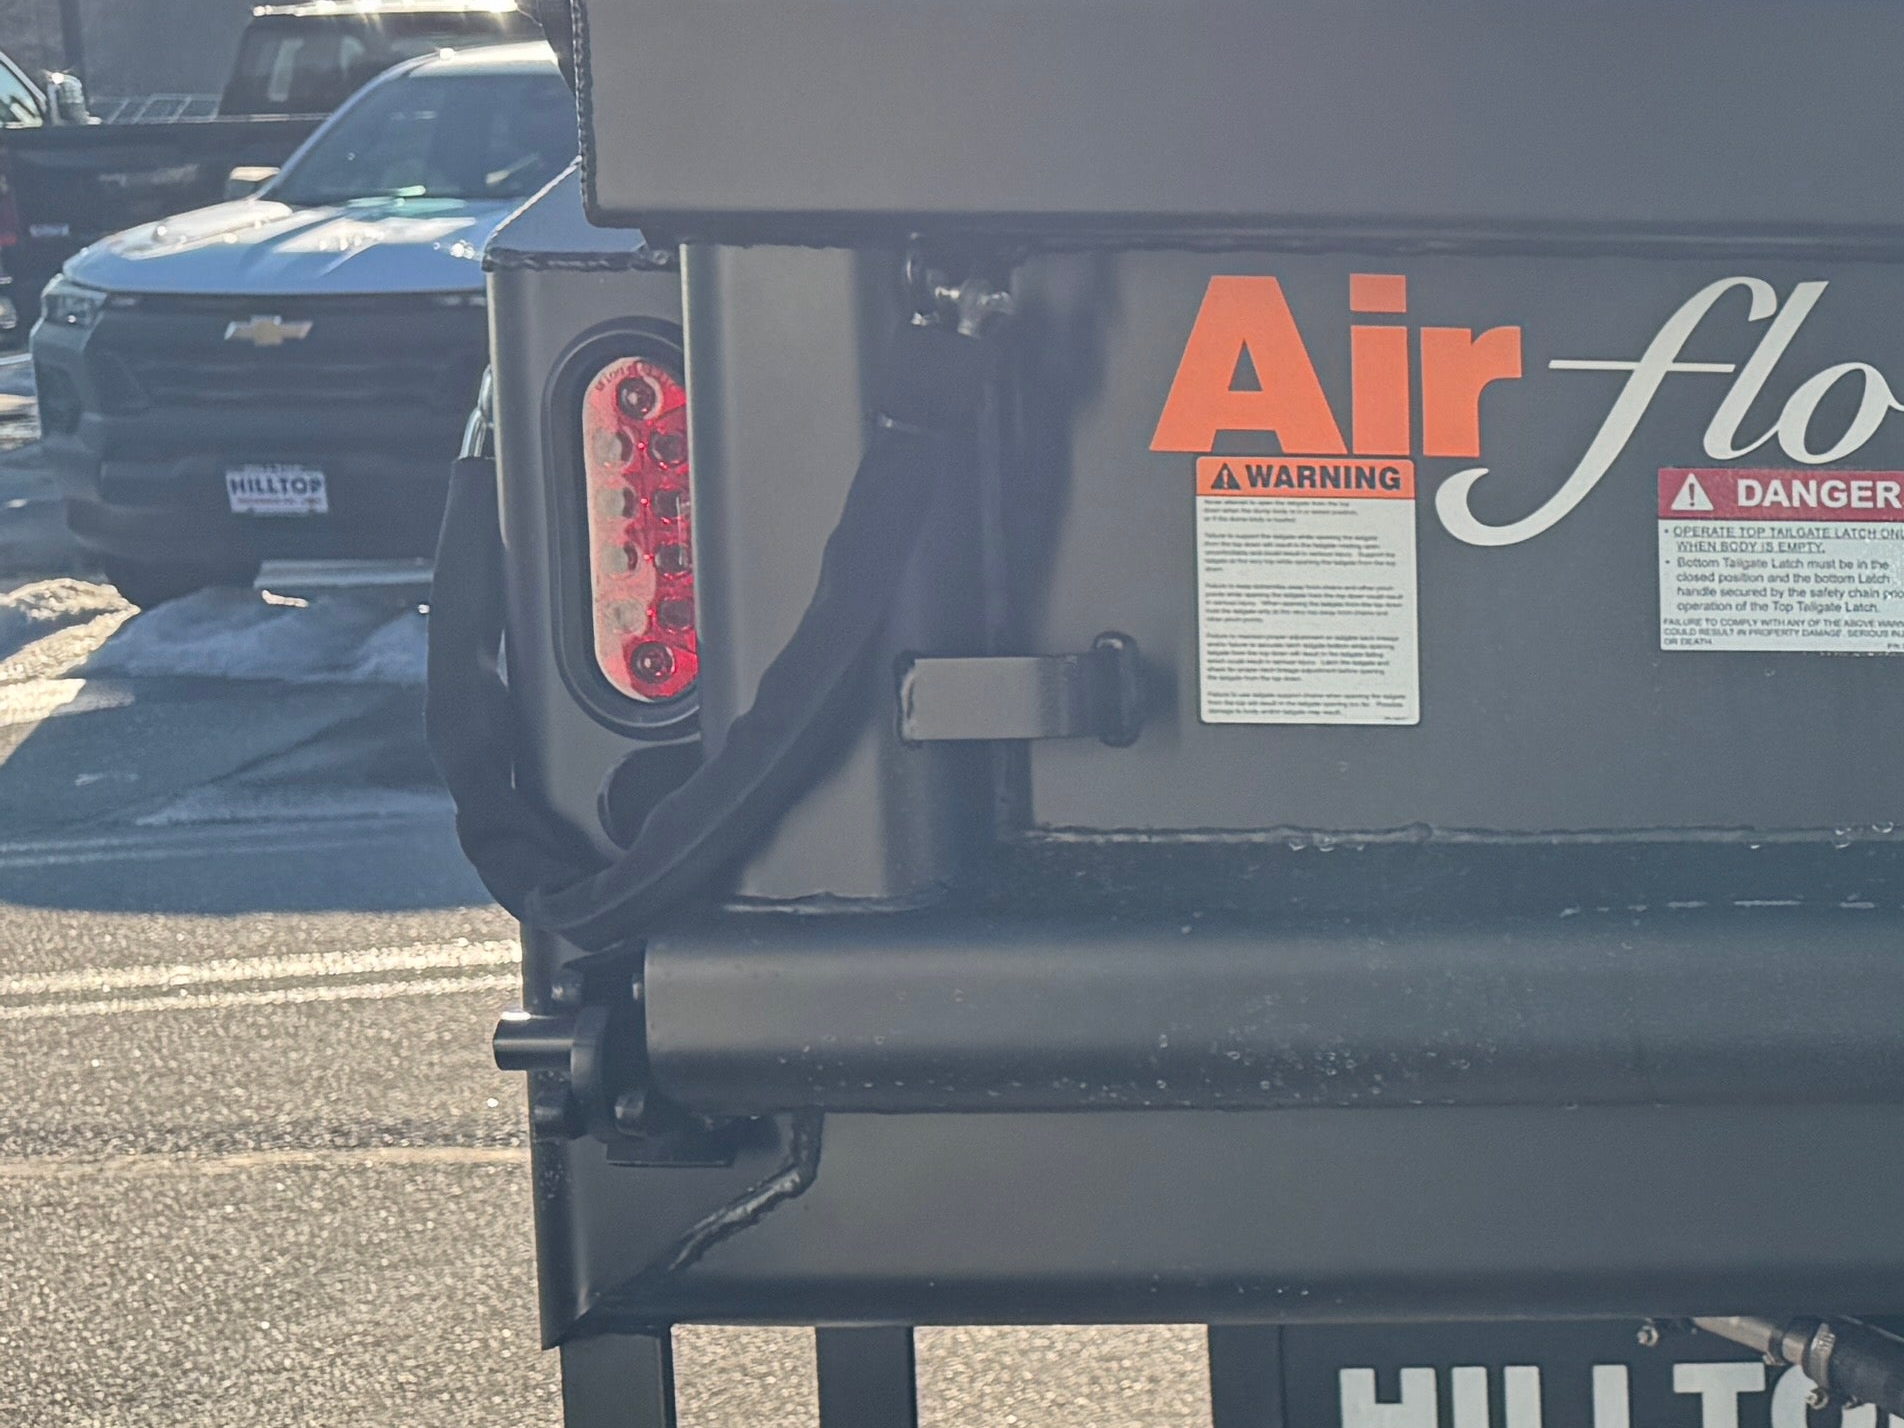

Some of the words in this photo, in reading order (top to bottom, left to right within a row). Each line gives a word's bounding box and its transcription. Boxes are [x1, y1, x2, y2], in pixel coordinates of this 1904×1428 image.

[1149, 273, 1521, 457] Air
[1245, 464, 1400, 490] WARNING
[230, 477, 322, 495] HILLTOP
[1737, 479, 1902, 508] DANGER
[1677, 557, 1719, 569] Bottom
[1722, 558, 1768, 569] Tailgate
[1771, 558, 1804, 570] Latch
[1807, 559, 1835, 570] must
[1677, 572, 1715, 583] closed
[1718, 572, 1764, 583] position
[1767, 573, 1790, 583] and
[1792, 573, 1811, 583] the
[1814, 573, 1855, 584] bottom
[1858, 573, 1889, 584] Latch
[1677, 586, 1716, 597] handle
[1719, 587, 1767, 598] secured
[1787, 587, 1806, 598] the
[1809, 587, 1845, 598] safety
[1848, 588, 1879, 599] chain
[1677, 601, 1732, 612] operation
[1749, 601, 1768, 612] the
[1771, 601, 1793, 612] Top
[1796, 602, 1841, 612] Tailgate
[1844, 602, 1878, 613] Latch.
